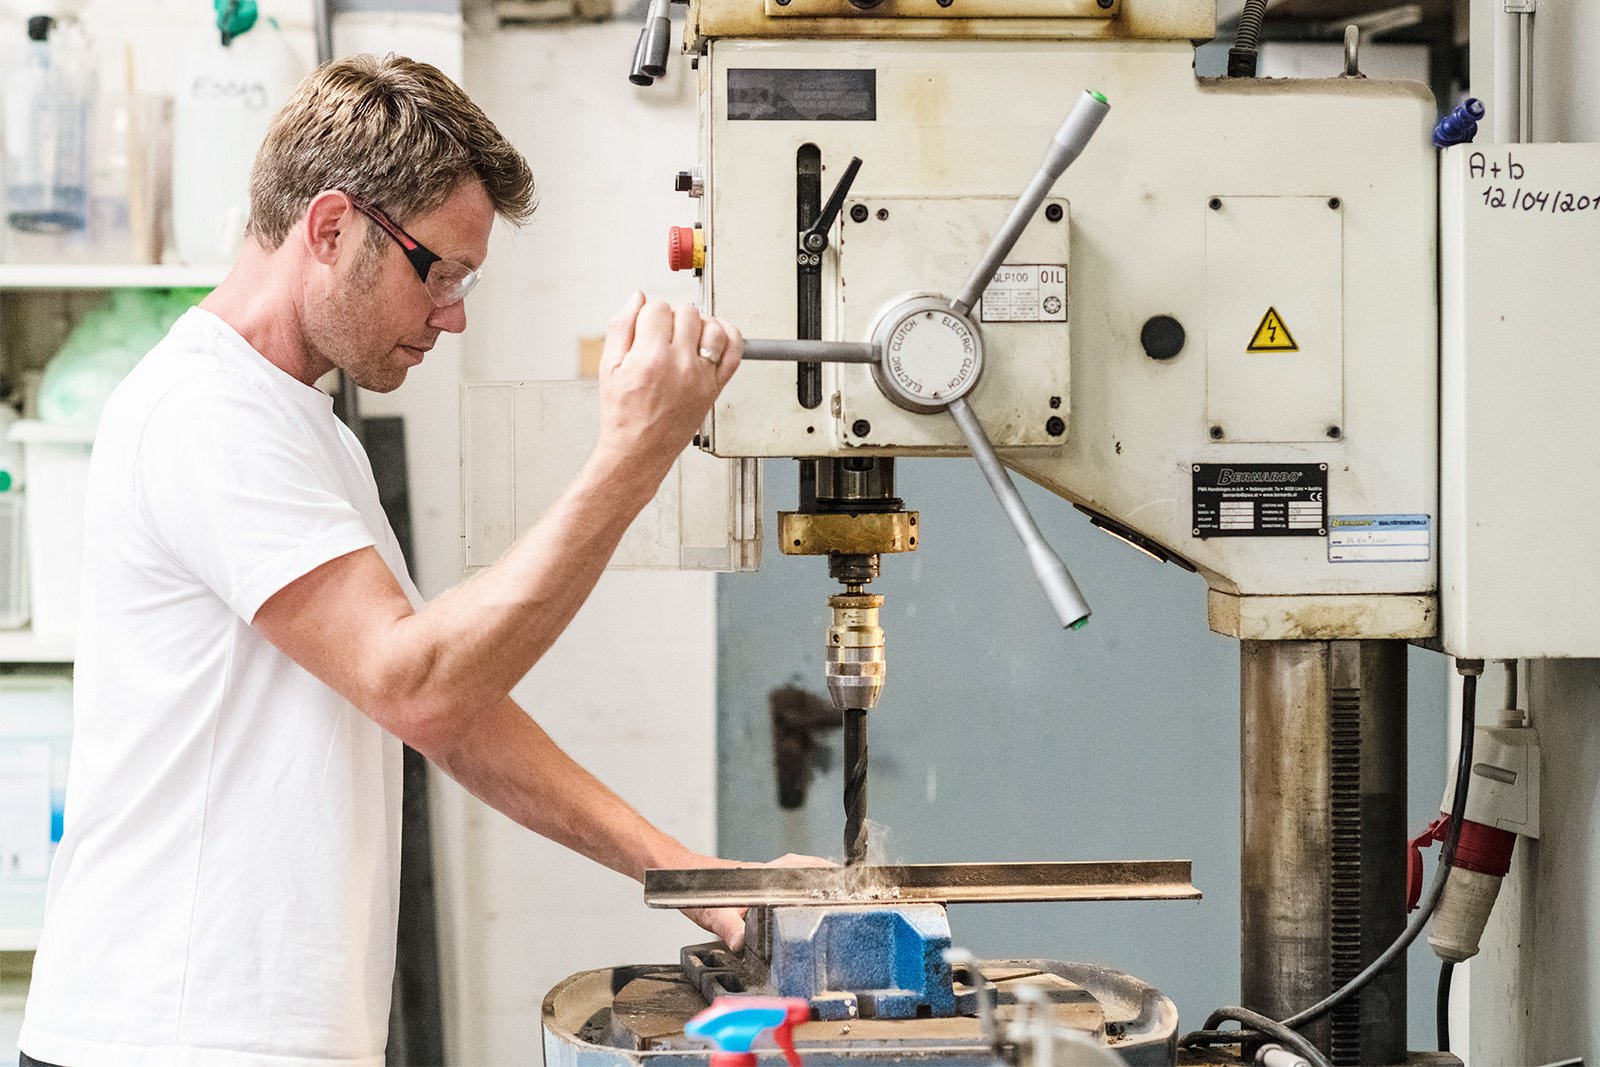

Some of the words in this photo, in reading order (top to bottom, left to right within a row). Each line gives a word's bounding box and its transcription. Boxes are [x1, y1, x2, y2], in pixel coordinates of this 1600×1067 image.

[1040, 270, 1064, 284] OIL
[892, 319, 918, 352] CLUTCH
[942, 316, 973, 354] ELECTRIC
[891, 356, 923, 394] ELECTRIC
[947, 358, 973, 390] CLUTCH
